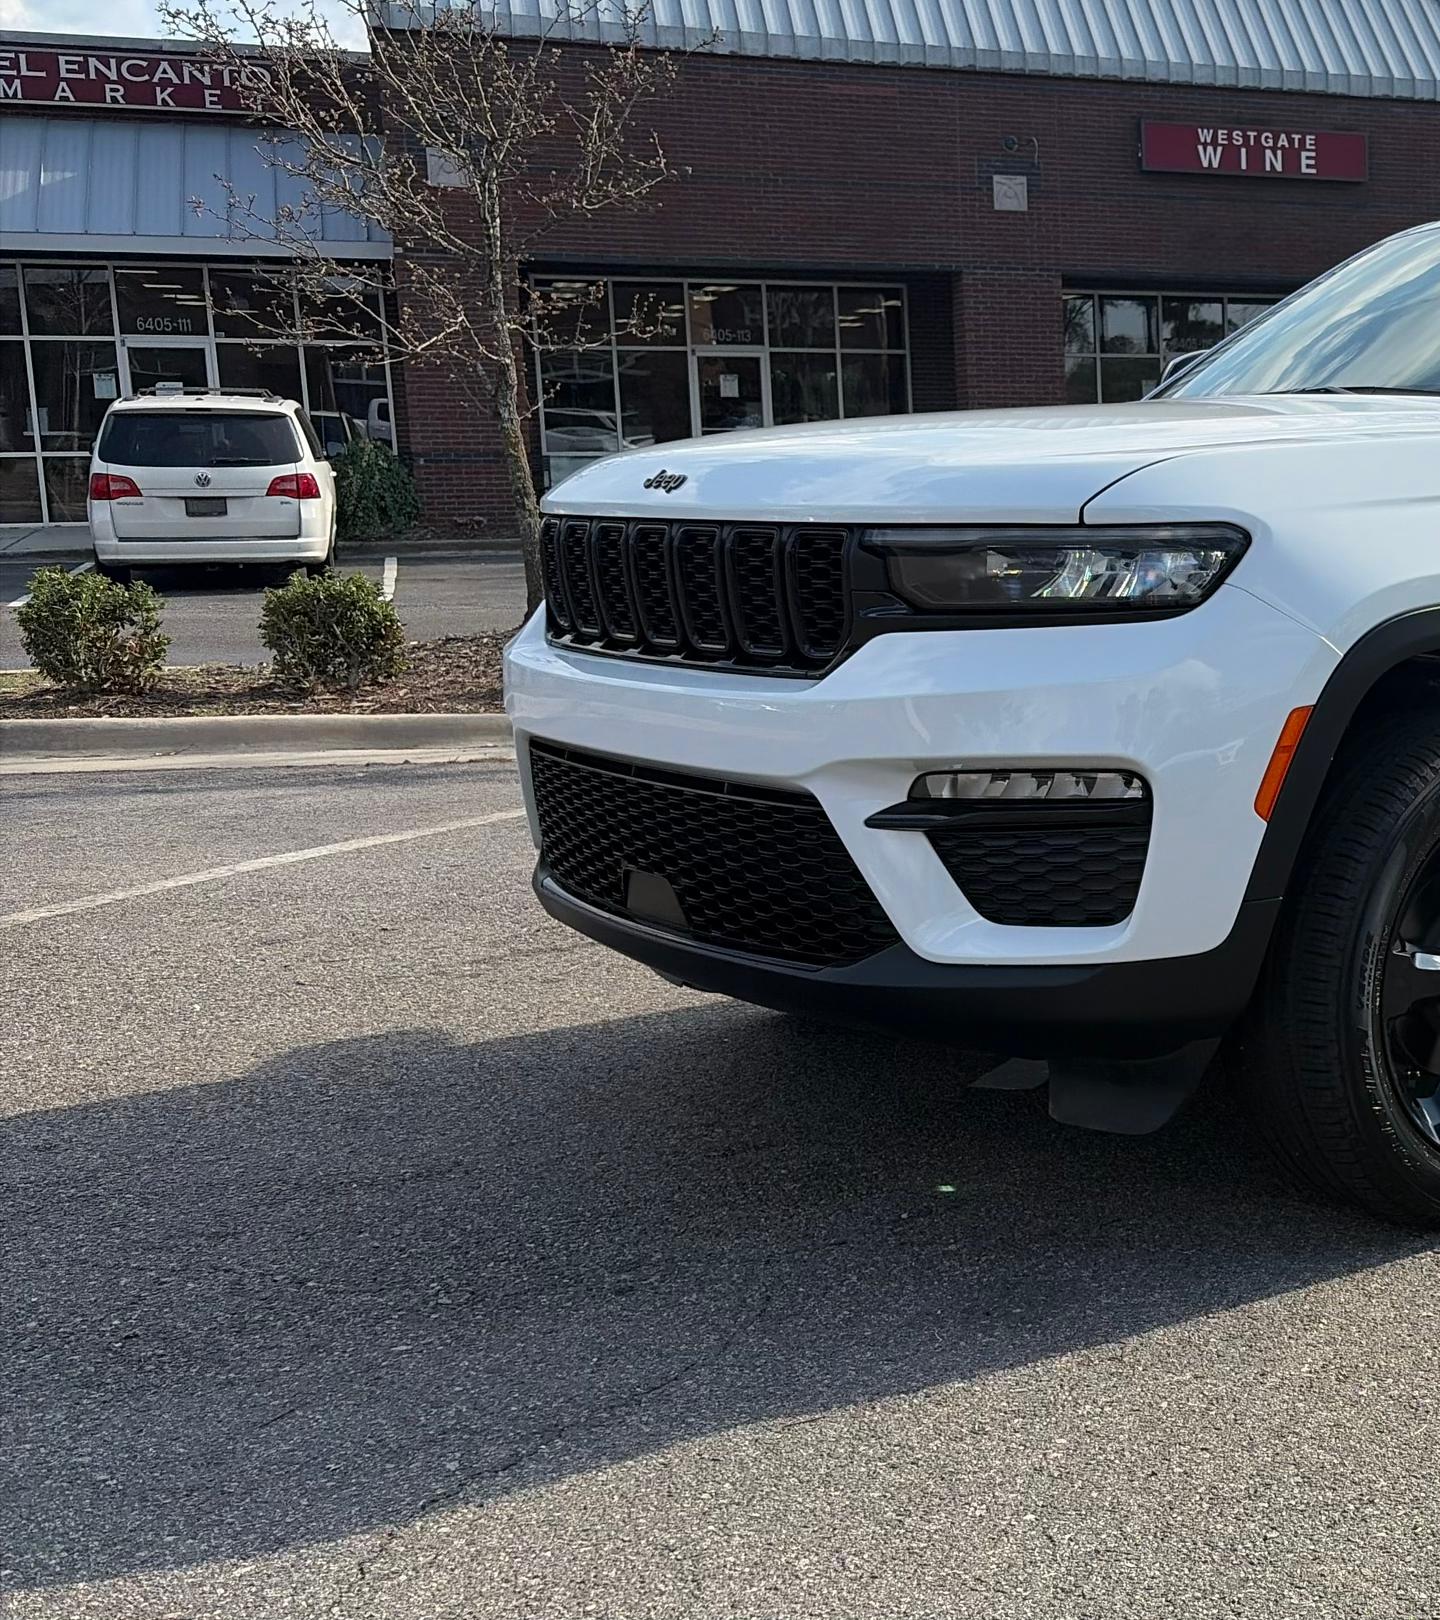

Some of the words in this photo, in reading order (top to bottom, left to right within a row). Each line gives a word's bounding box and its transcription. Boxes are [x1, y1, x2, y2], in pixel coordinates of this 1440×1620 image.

[0, 52, 47, 77] EL
[58, 55, 272, 87] ENCANTO
[1197, 127, 1317, 150] WESTGATE
[1197, 145, 1317, 174] WINE
[136, 316, 192, 332] 6405-111
[703, 327, 752, 343] 6405-113
[643, 469, 688, 494] Jeep
